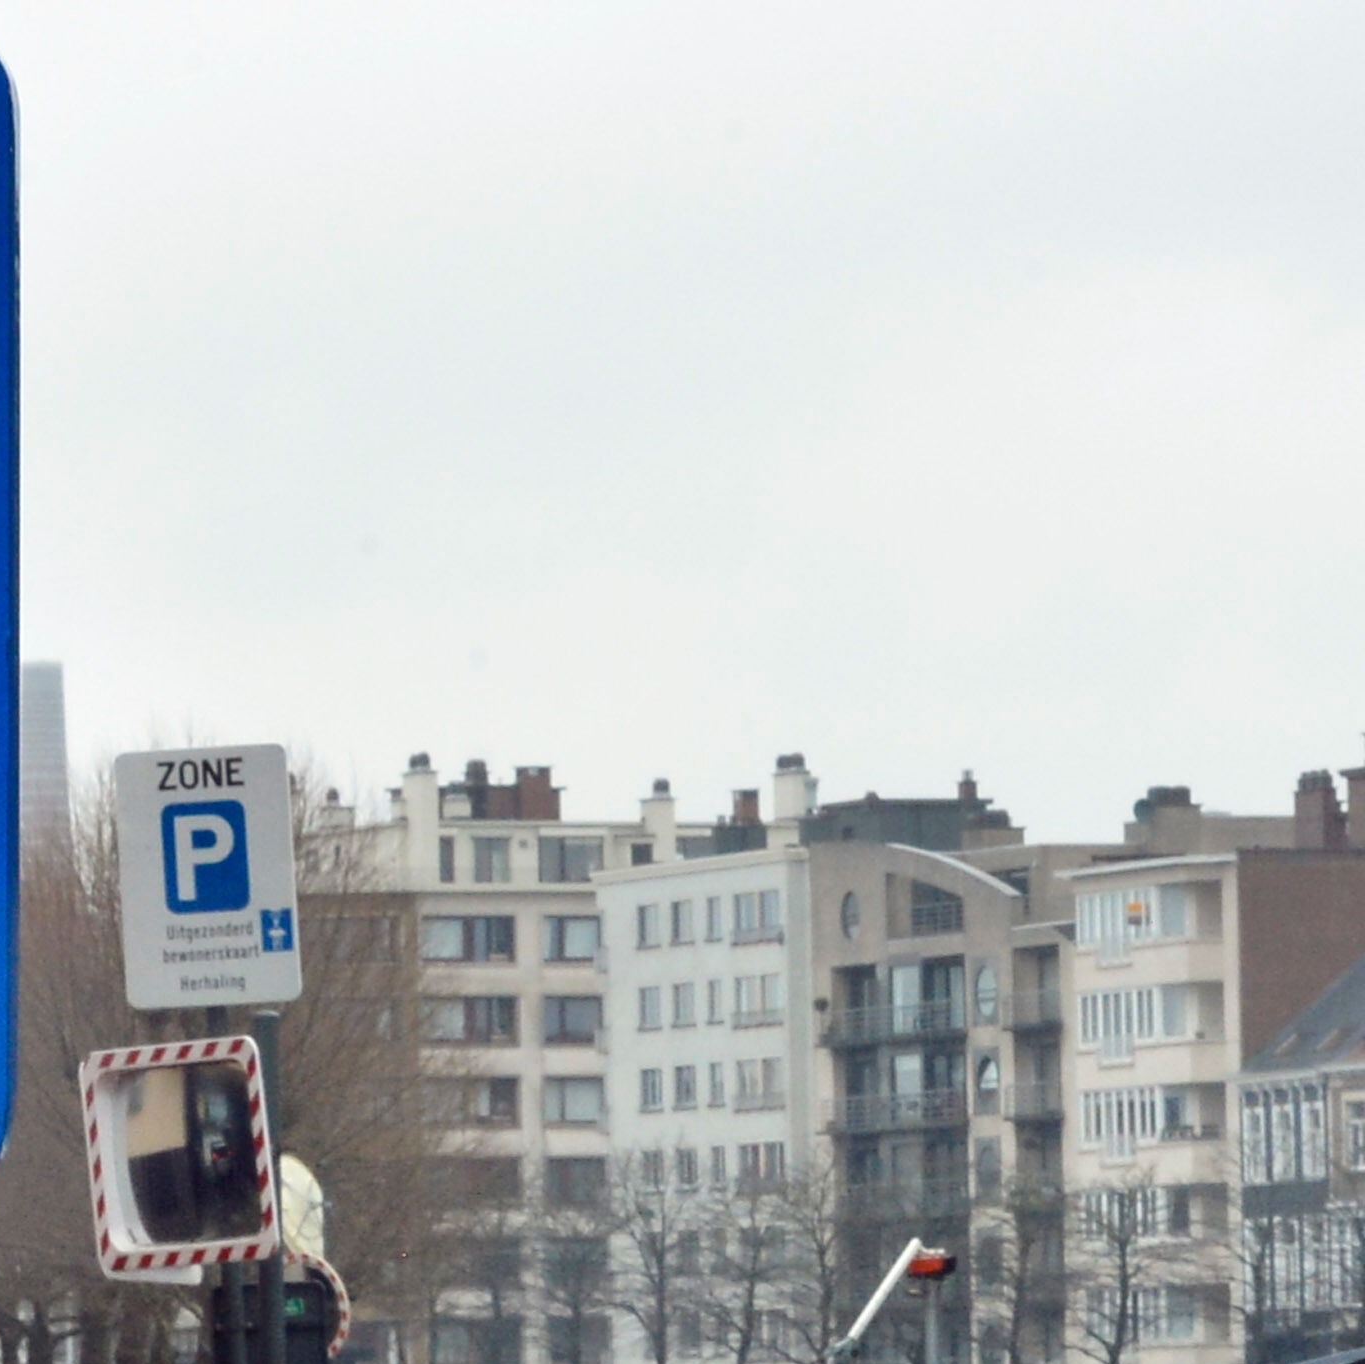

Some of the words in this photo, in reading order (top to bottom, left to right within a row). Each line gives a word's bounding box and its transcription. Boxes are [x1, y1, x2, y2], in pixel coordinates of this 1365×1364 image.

[157, 757, 245, 791] ZONE
[174, 814, 234, 901] P
[166, 922, 254, 943] Uitgezonderd
[163, 945, 259, 964] bewonerskaart
[180, 975, 246, 991] Herhaling
